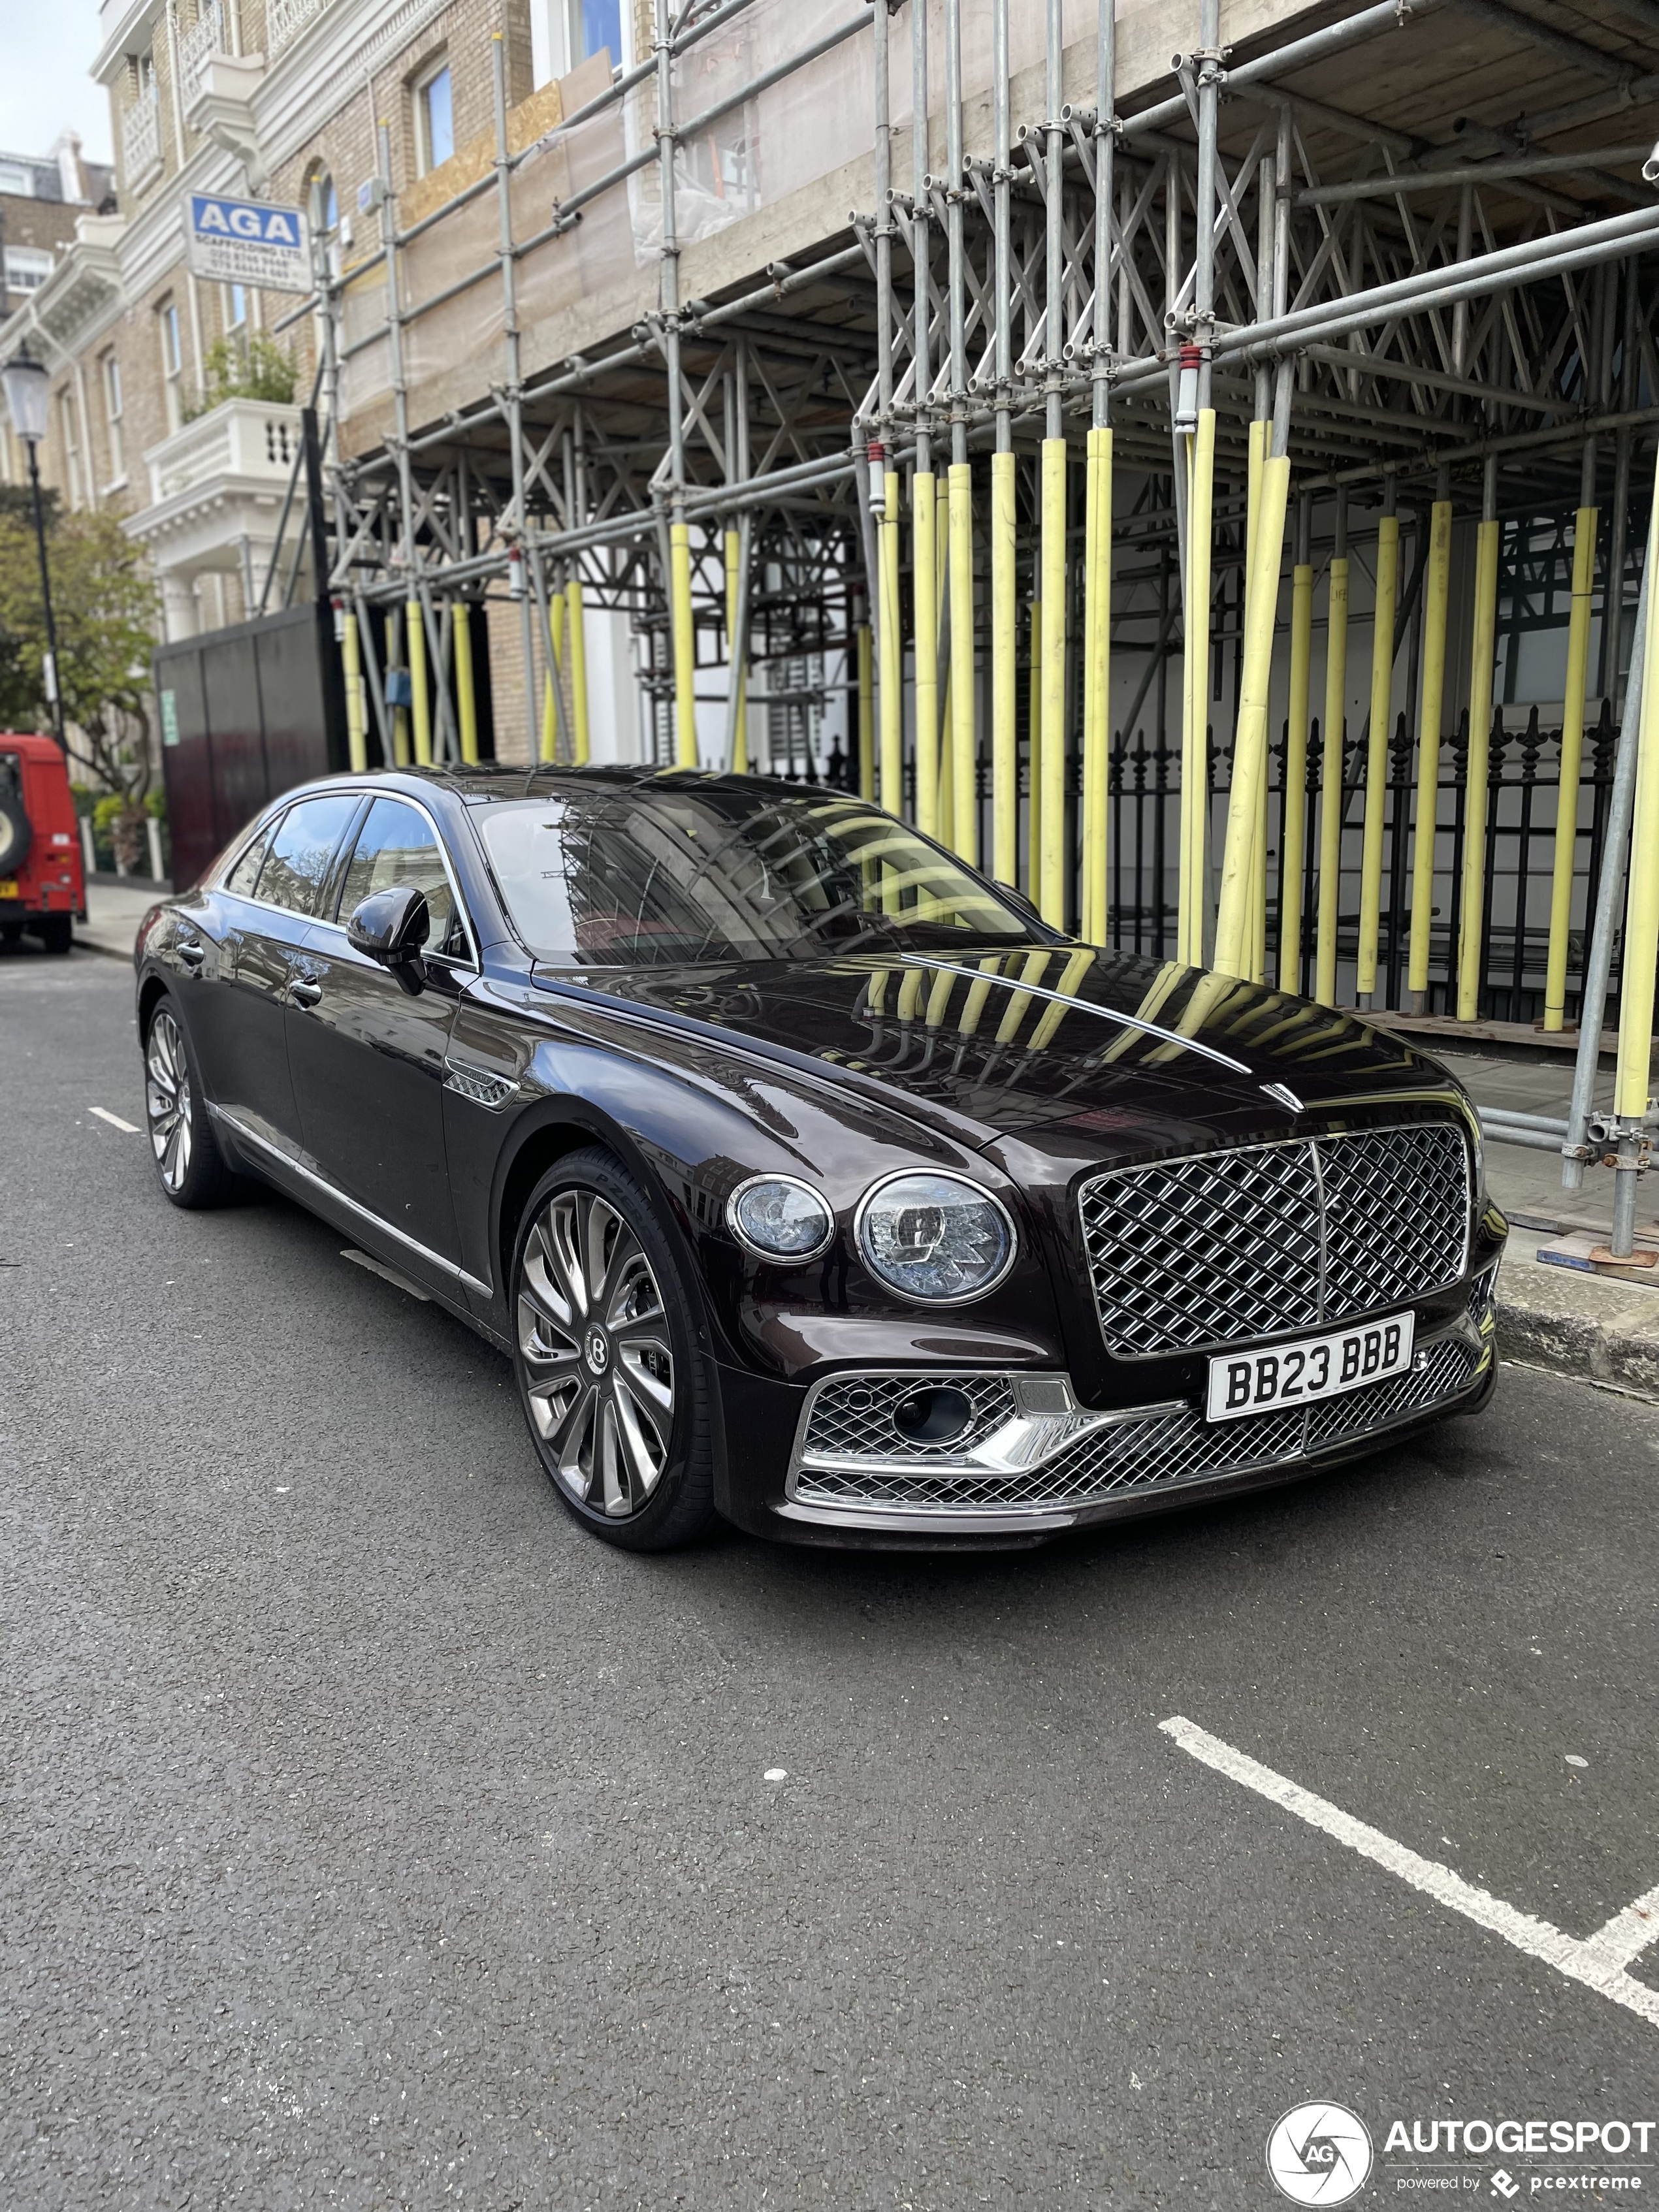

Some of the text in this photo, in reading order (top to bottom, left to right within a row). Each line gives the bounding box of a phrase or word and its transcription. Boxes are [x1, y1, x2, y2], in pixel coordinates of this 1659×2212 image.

[199, 203, 295, 243] AGA
[195, 234, 302, 260] SCAFFOLDING LTD
[595, 1174, 609, 1183] P
[593, 1338, 605, 1364] B
[1225, 1323, 1401, 1410] BB23 BBB
